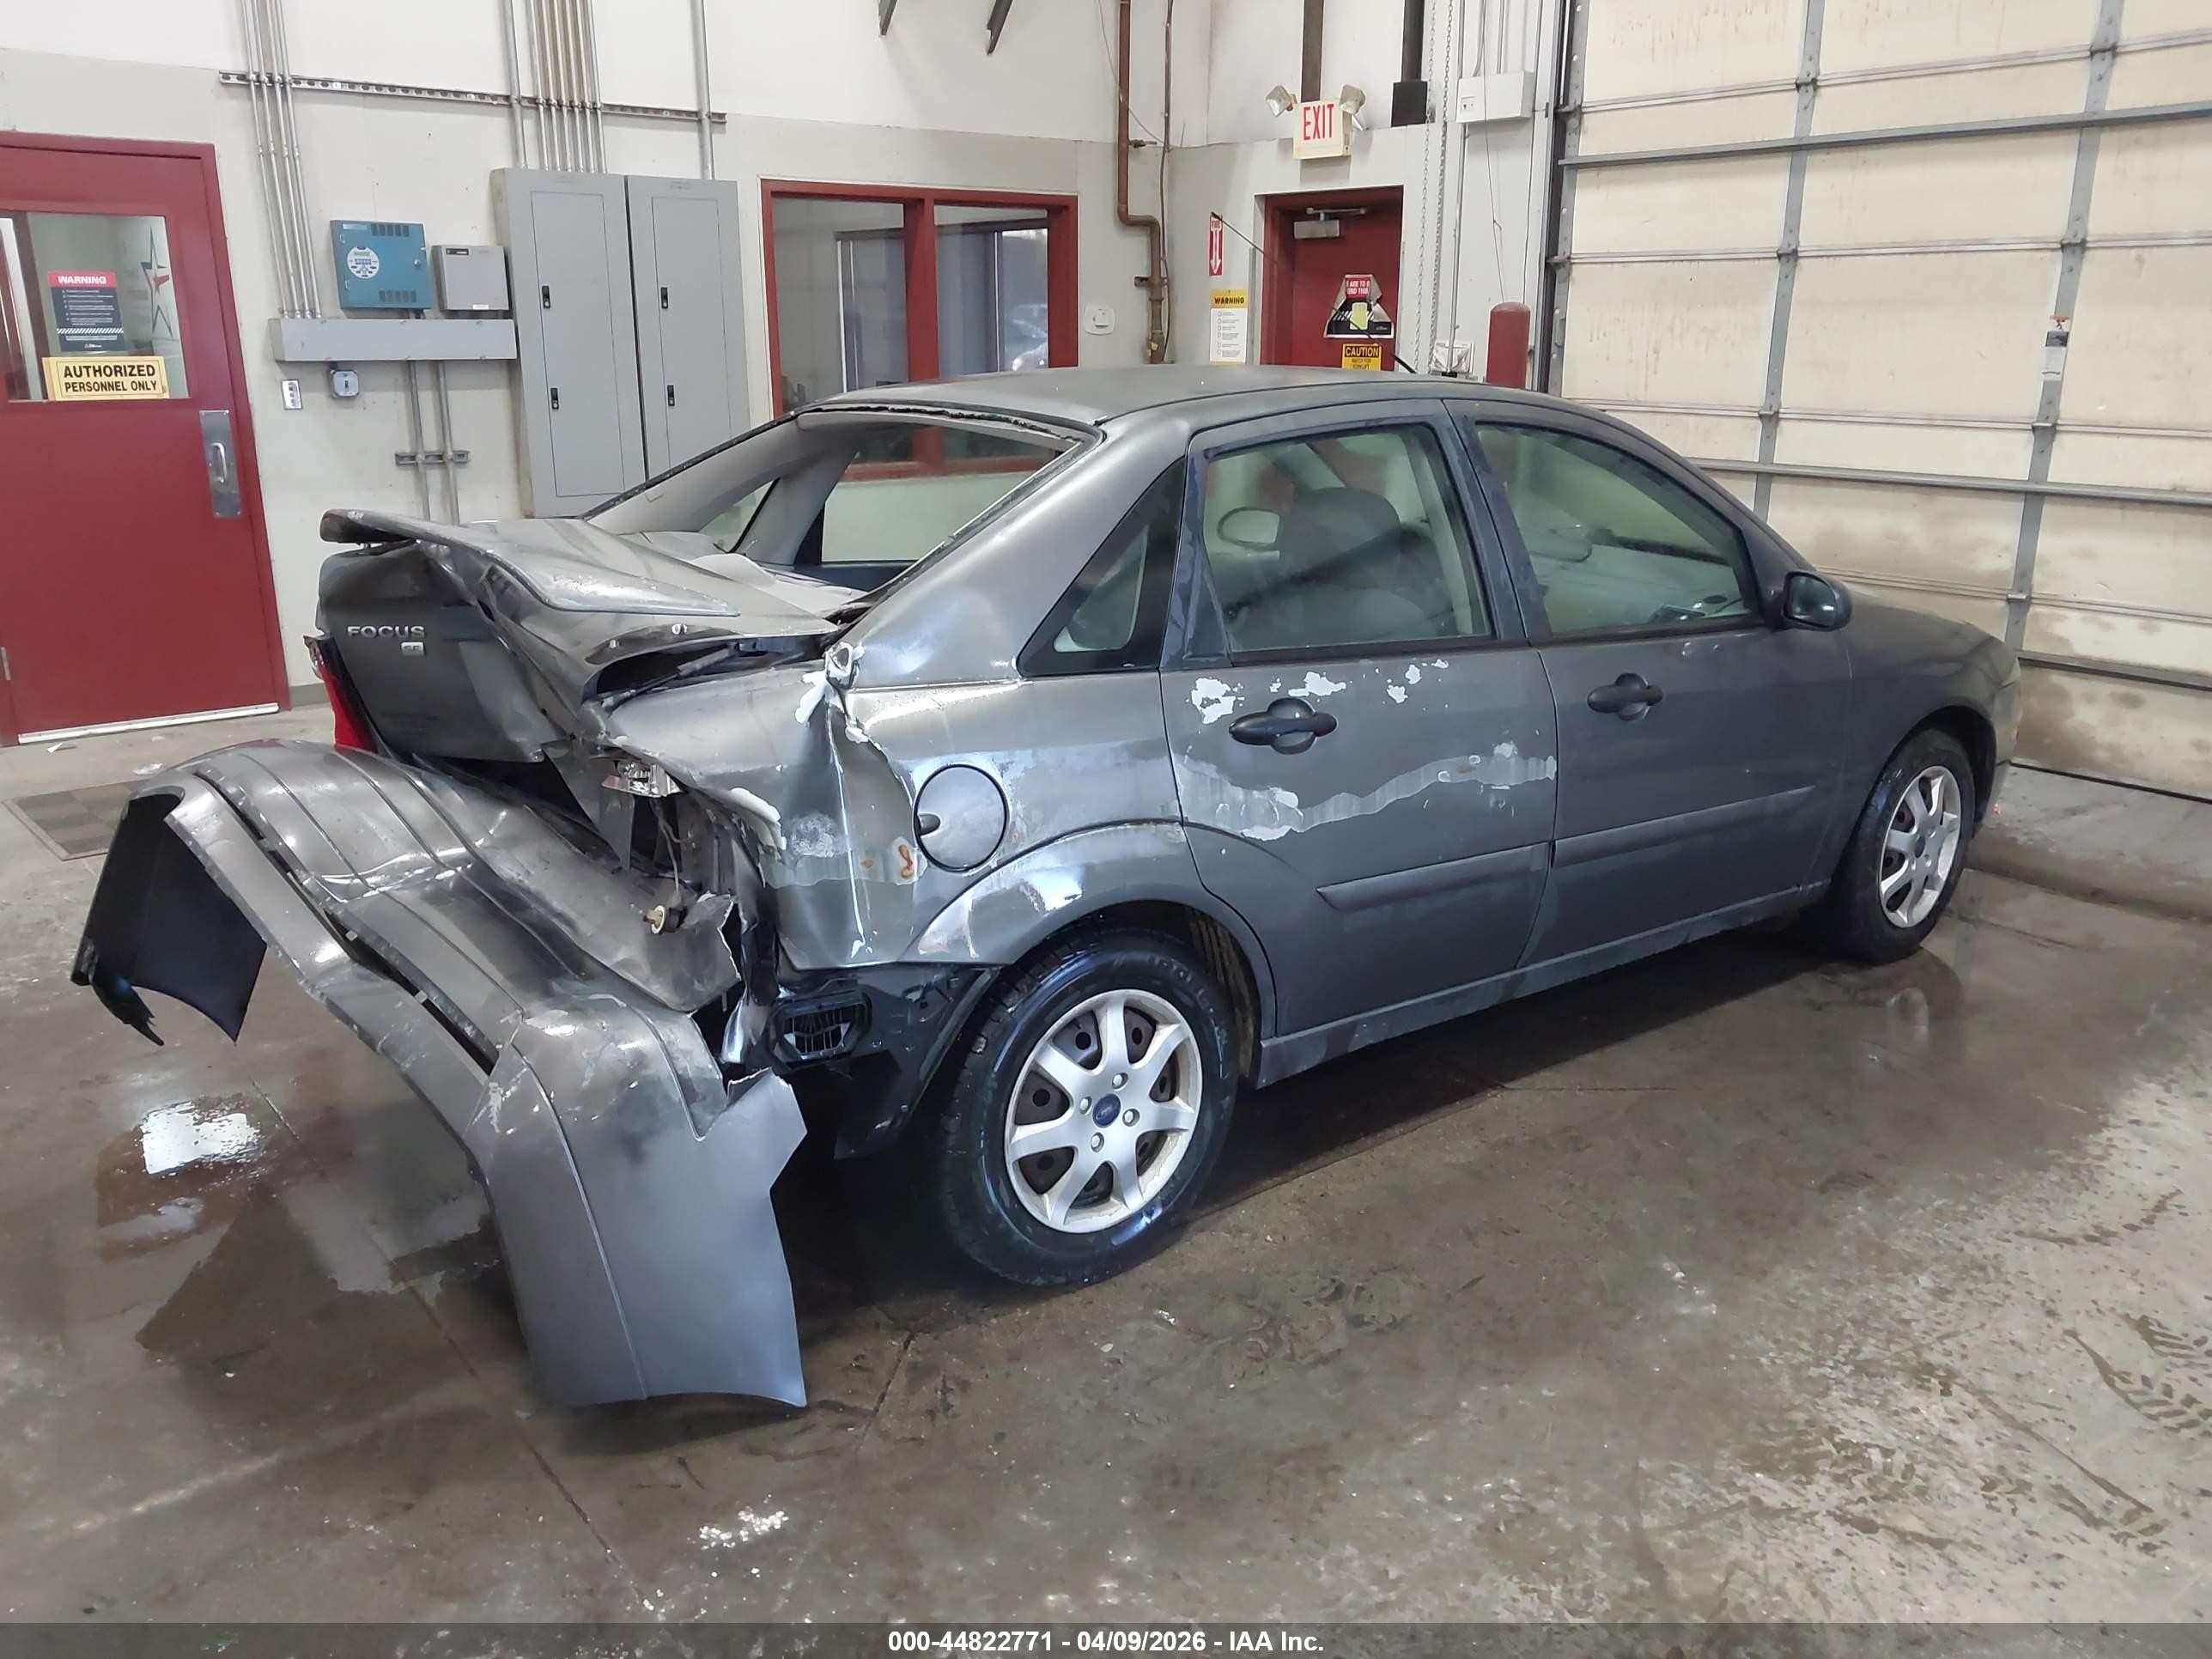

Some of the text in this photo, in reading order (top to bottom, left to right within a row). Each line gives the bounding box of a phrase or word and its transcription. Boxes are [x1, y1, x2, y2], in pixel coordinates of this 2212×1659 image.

[1303, 104, 1334, 141] EXIT
[57, 276, 107, 284] WARNING
[1214, 296, 1245, 305] WARNING
[1346, 346, 1379, 357] CAUTION
[64, 364, 156, 378] AUTHORIZED
[64, 380, 157, 392] PERSONNEL ONLY
[347, 625, 426, 638] FOCUS
